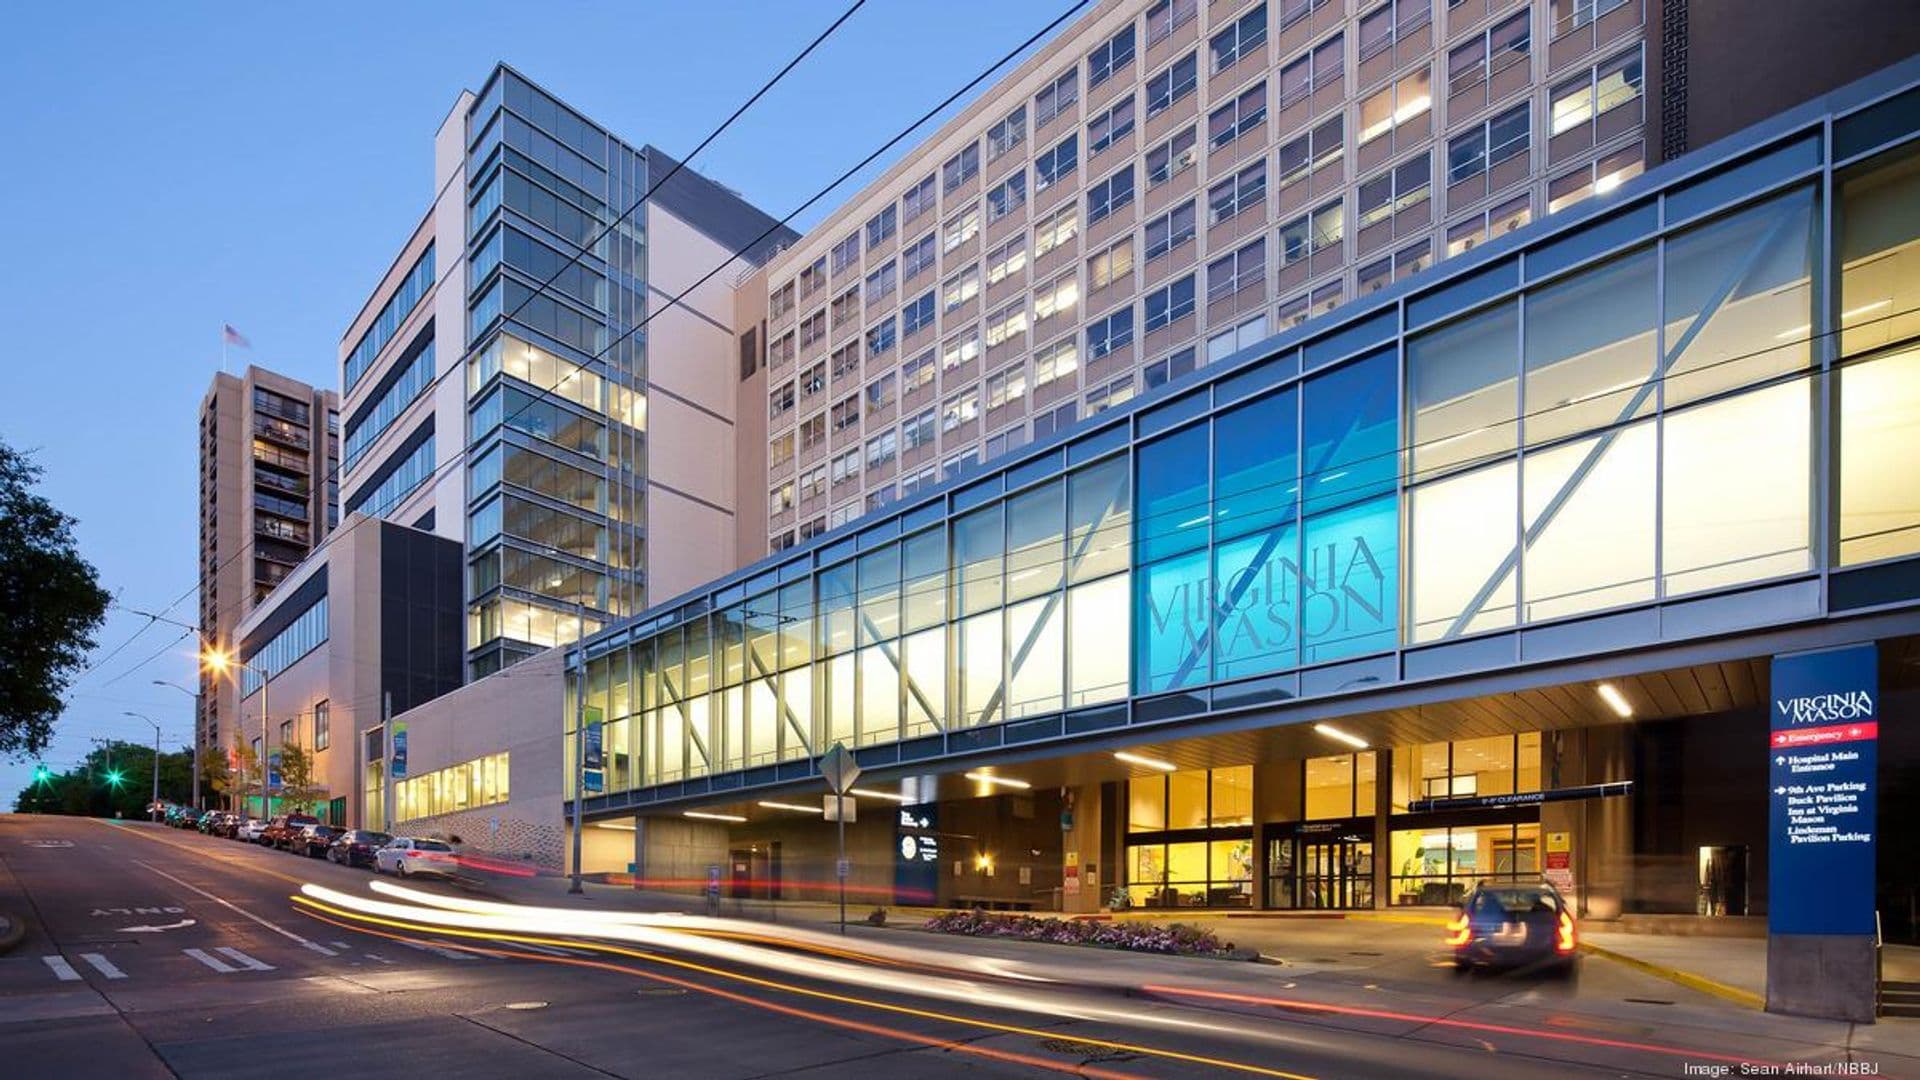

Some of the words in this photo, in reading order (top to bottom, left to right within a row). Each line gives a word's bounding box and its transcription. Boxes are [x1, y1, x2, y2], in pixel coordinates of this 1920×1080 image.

[1146, 536, 1385, 635] VIRGINIA
[1178, 575, 1385, 667] MASON
[1777, 690, 1872, 715] VIRGINIA
[1791, 701, 1872, 724] MASON
[1788, 732, 1843, 742] Emergency
[1788, 753, 1830, 765] Hospital
[1832, 751, 1859, 761] Main
[1791, 763, 1835, 773] Entrance
[1805, 785, 1825, 794] Ave
[1827, 782, 1867, 792] Parking
[1788, 808, 1805, 816] Inn
[1817, 804, 1858, 815] Virginia
[1791, 816, 1825, 824] Mason
[1788, 826, 1837, 835] Lindeman
[1791, 834, 1830, 844] Pavilion
[1832, 832, 1871, 842] Parking
